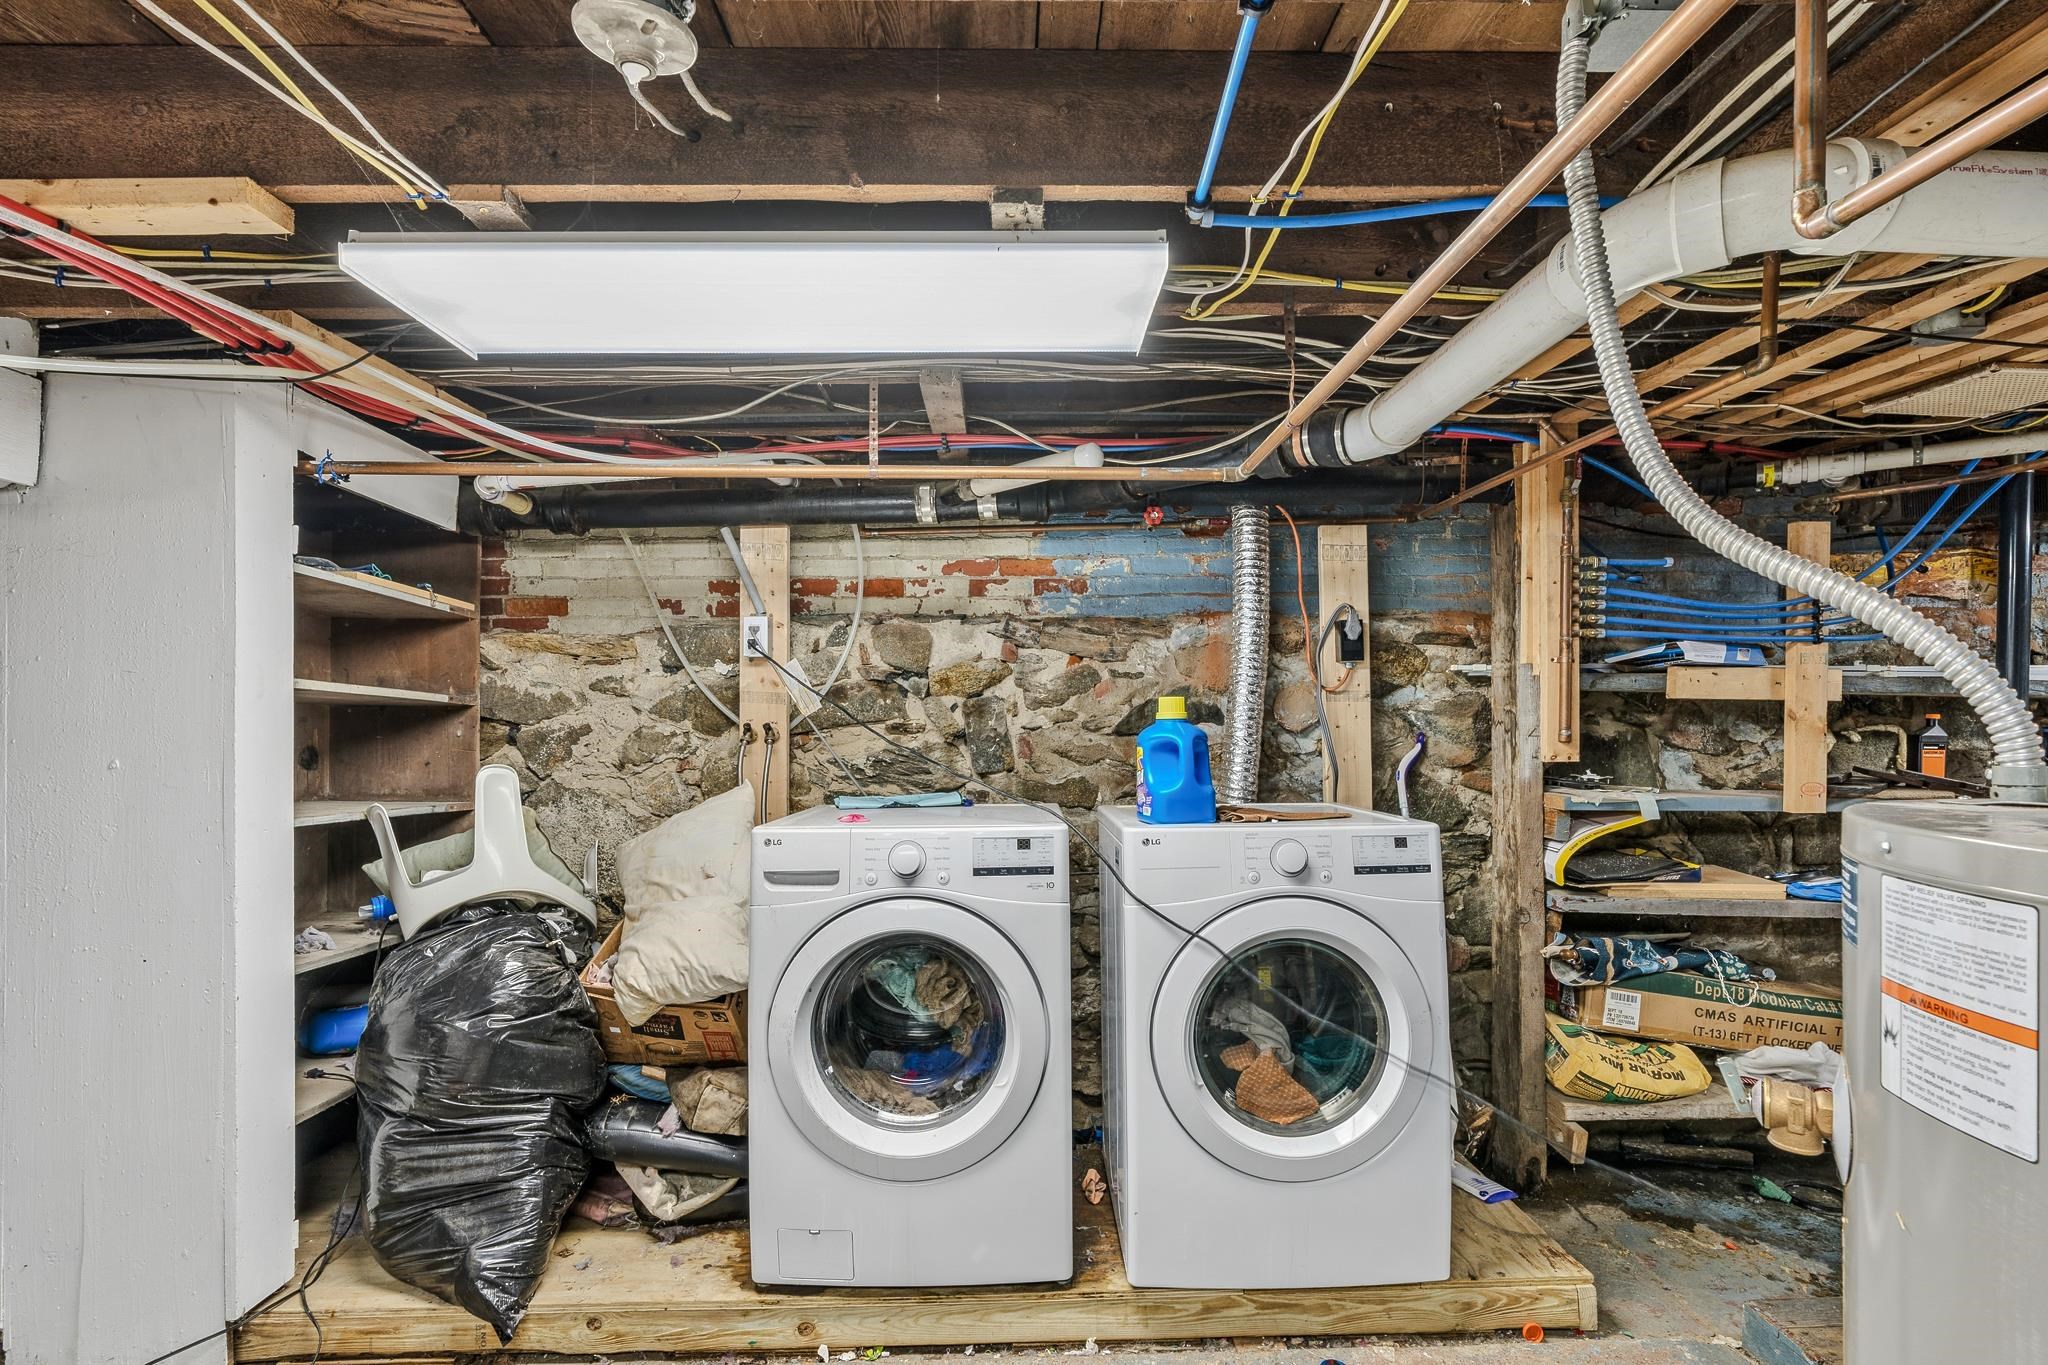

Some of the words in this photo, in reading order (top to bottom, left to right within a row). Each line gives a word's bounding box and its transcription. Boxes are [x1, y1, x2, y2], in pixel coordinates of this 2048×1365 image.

[1917, 887, 1934, 896] RELIEF
[1936, 892, 1954, 900] VALVE
[1956, 896, 1986, 907] OPENING
[1695, 980, 1727, 1000] Dep
[1694, 1007, 1737, 1023] CMAS
[1743, 1015, 1827, 1035] ARTIFICIAL
[1918, 996, 1969, 1024] WARNING
[1693, 1025, 1727, 1041] (T-13)
[1729, 1031, 1753, 1044] 6FT
[1756, 1035, 1812, 1050] FLOCKED
[1612, 1083, 1675, 1102] QUIKRE
